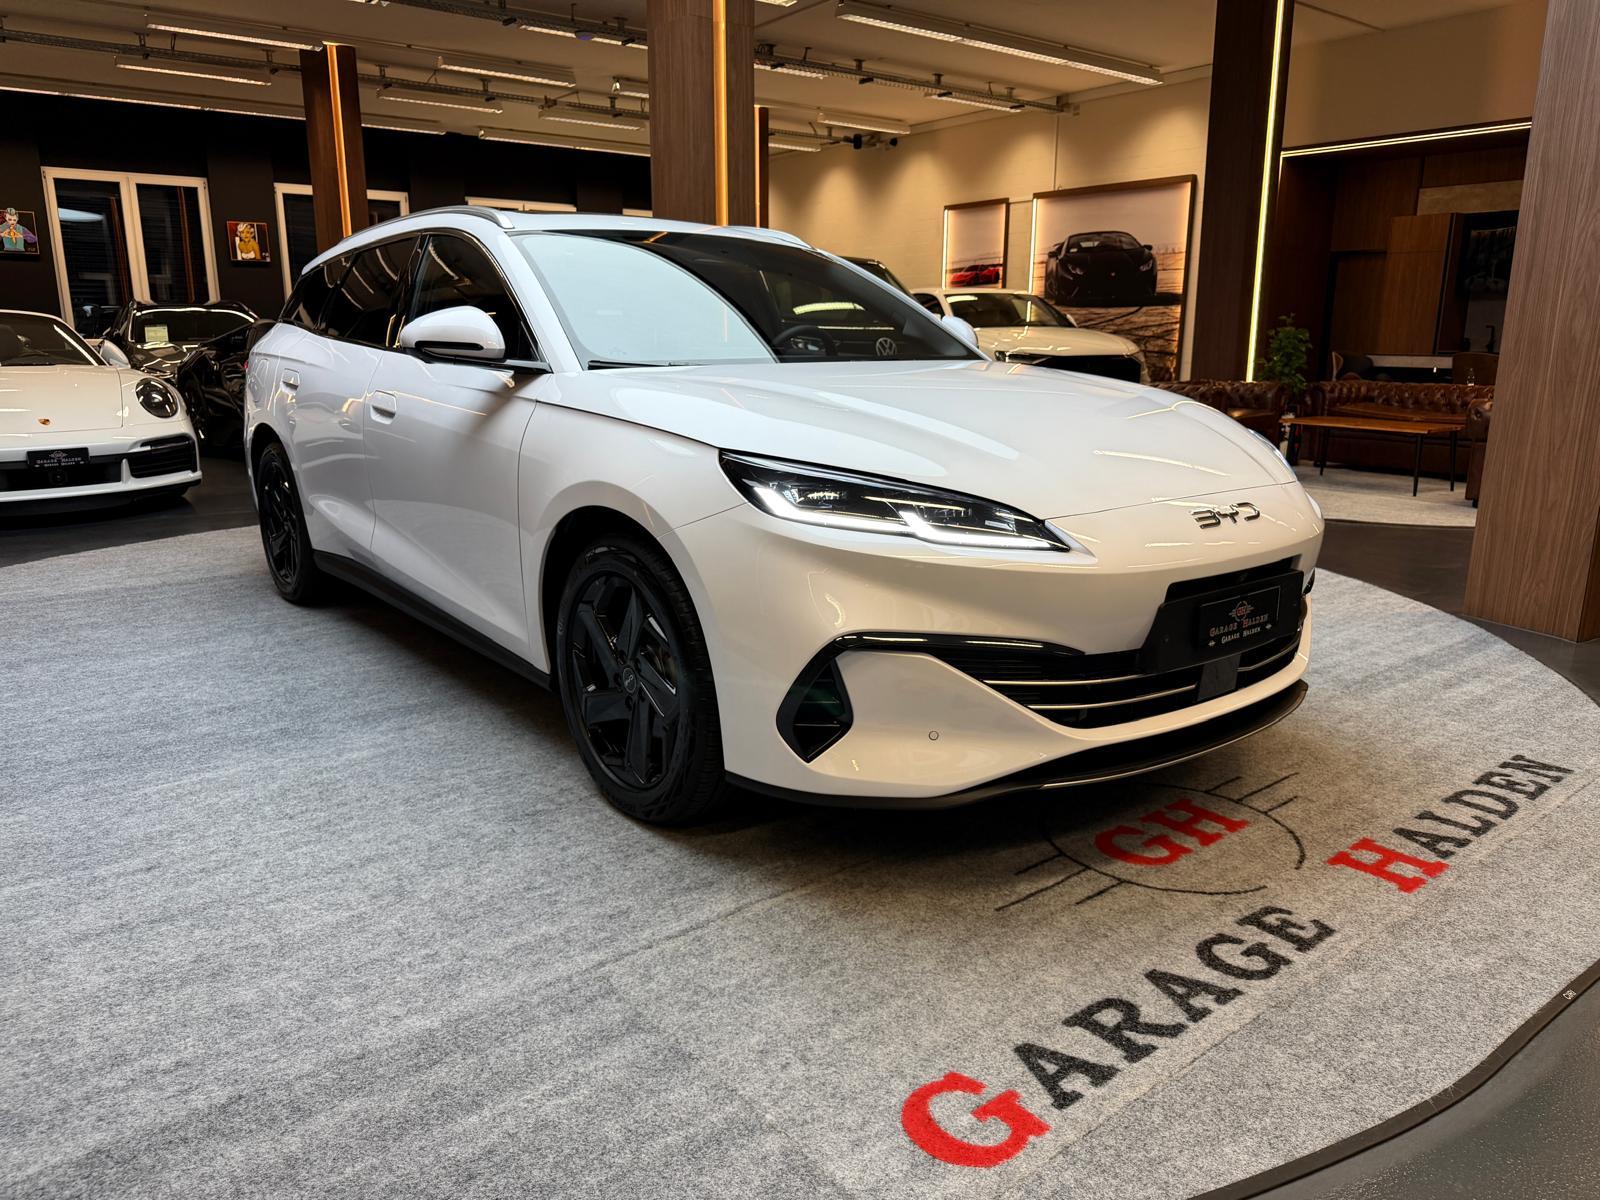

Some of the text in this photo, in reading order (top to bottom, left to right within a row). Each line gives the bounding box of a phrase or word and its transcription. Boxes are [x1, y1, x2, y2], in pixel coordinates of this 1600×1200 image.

[1191, 502, 1260, 529] BYD
[1093, 800, 1249, 867] GH
[901, 755, 1574, 1168] GARAGE HALDEN
